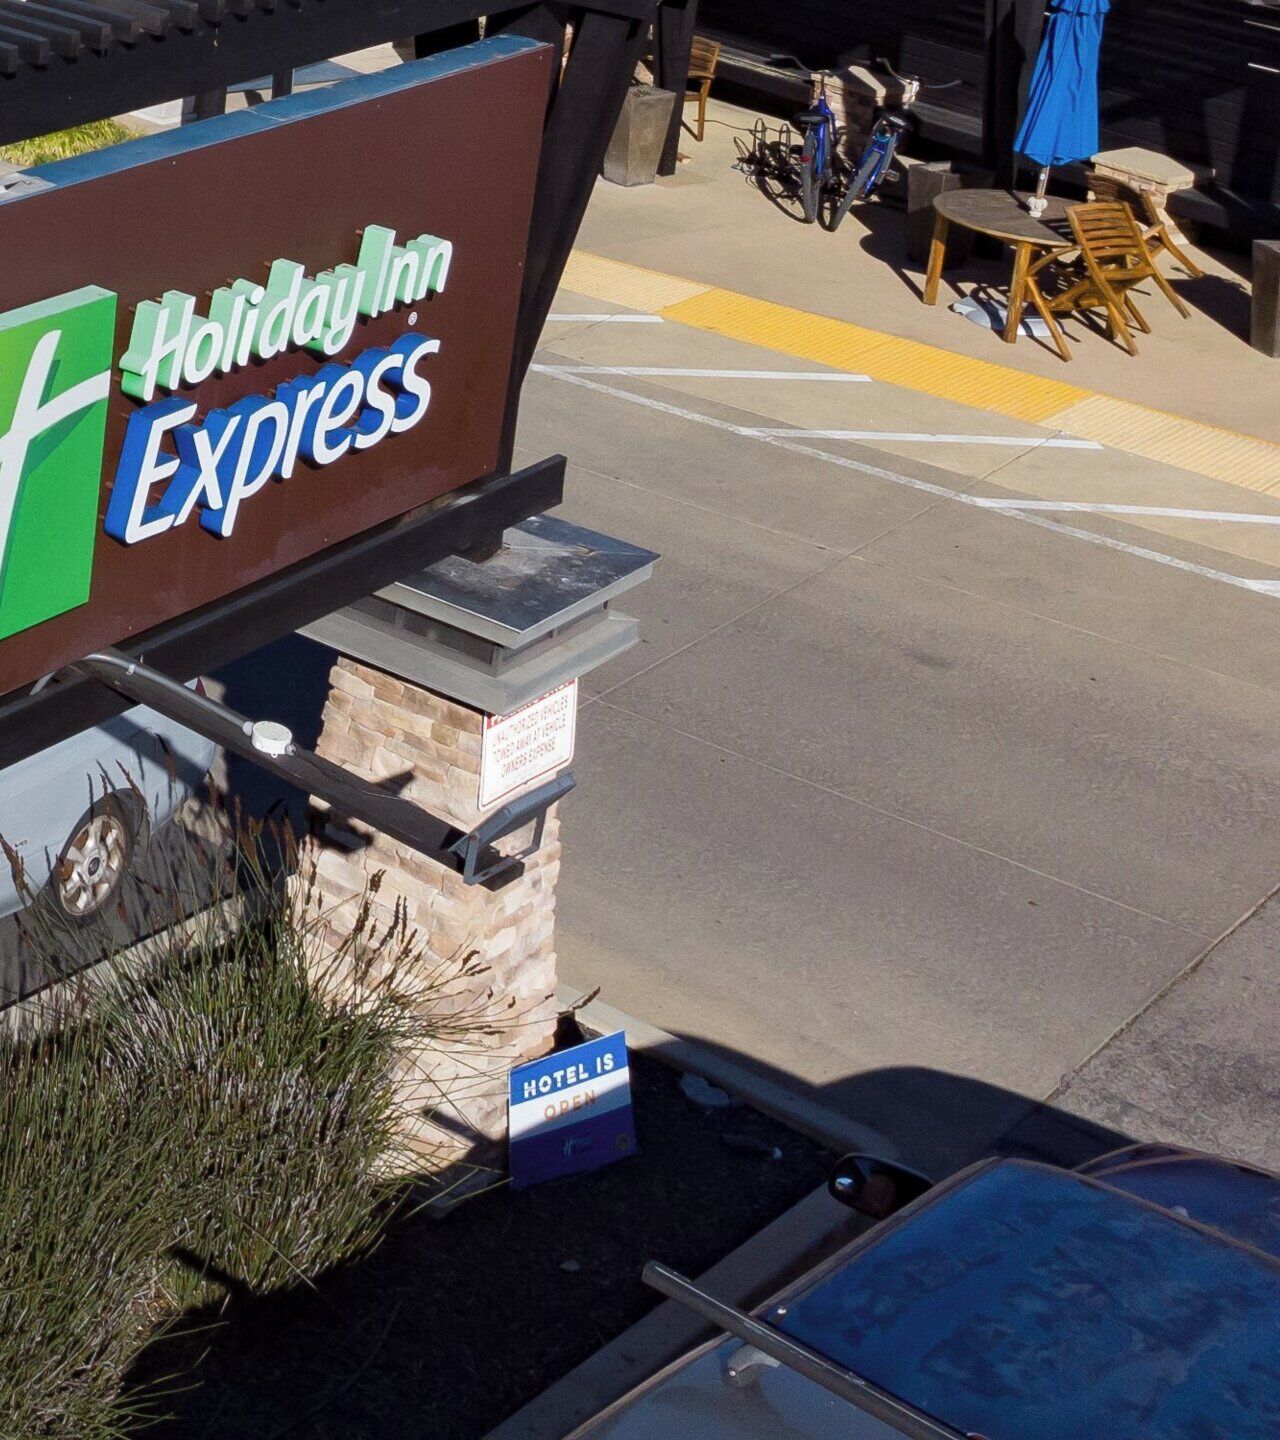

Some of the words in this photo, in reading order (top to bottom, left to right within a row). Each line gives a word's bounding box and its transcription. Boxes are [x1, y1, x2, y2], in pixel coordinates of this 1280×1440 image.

[124, 262, 366, 402] Holiday
[366, 226, 453, 319] Inn
[112, 336, 441, 545] Express
[523, 1063, 589, 1099] HOTEL
[596, 1052, 614, 1074] IS
[544, 1089, 596, 1121] OPEN
